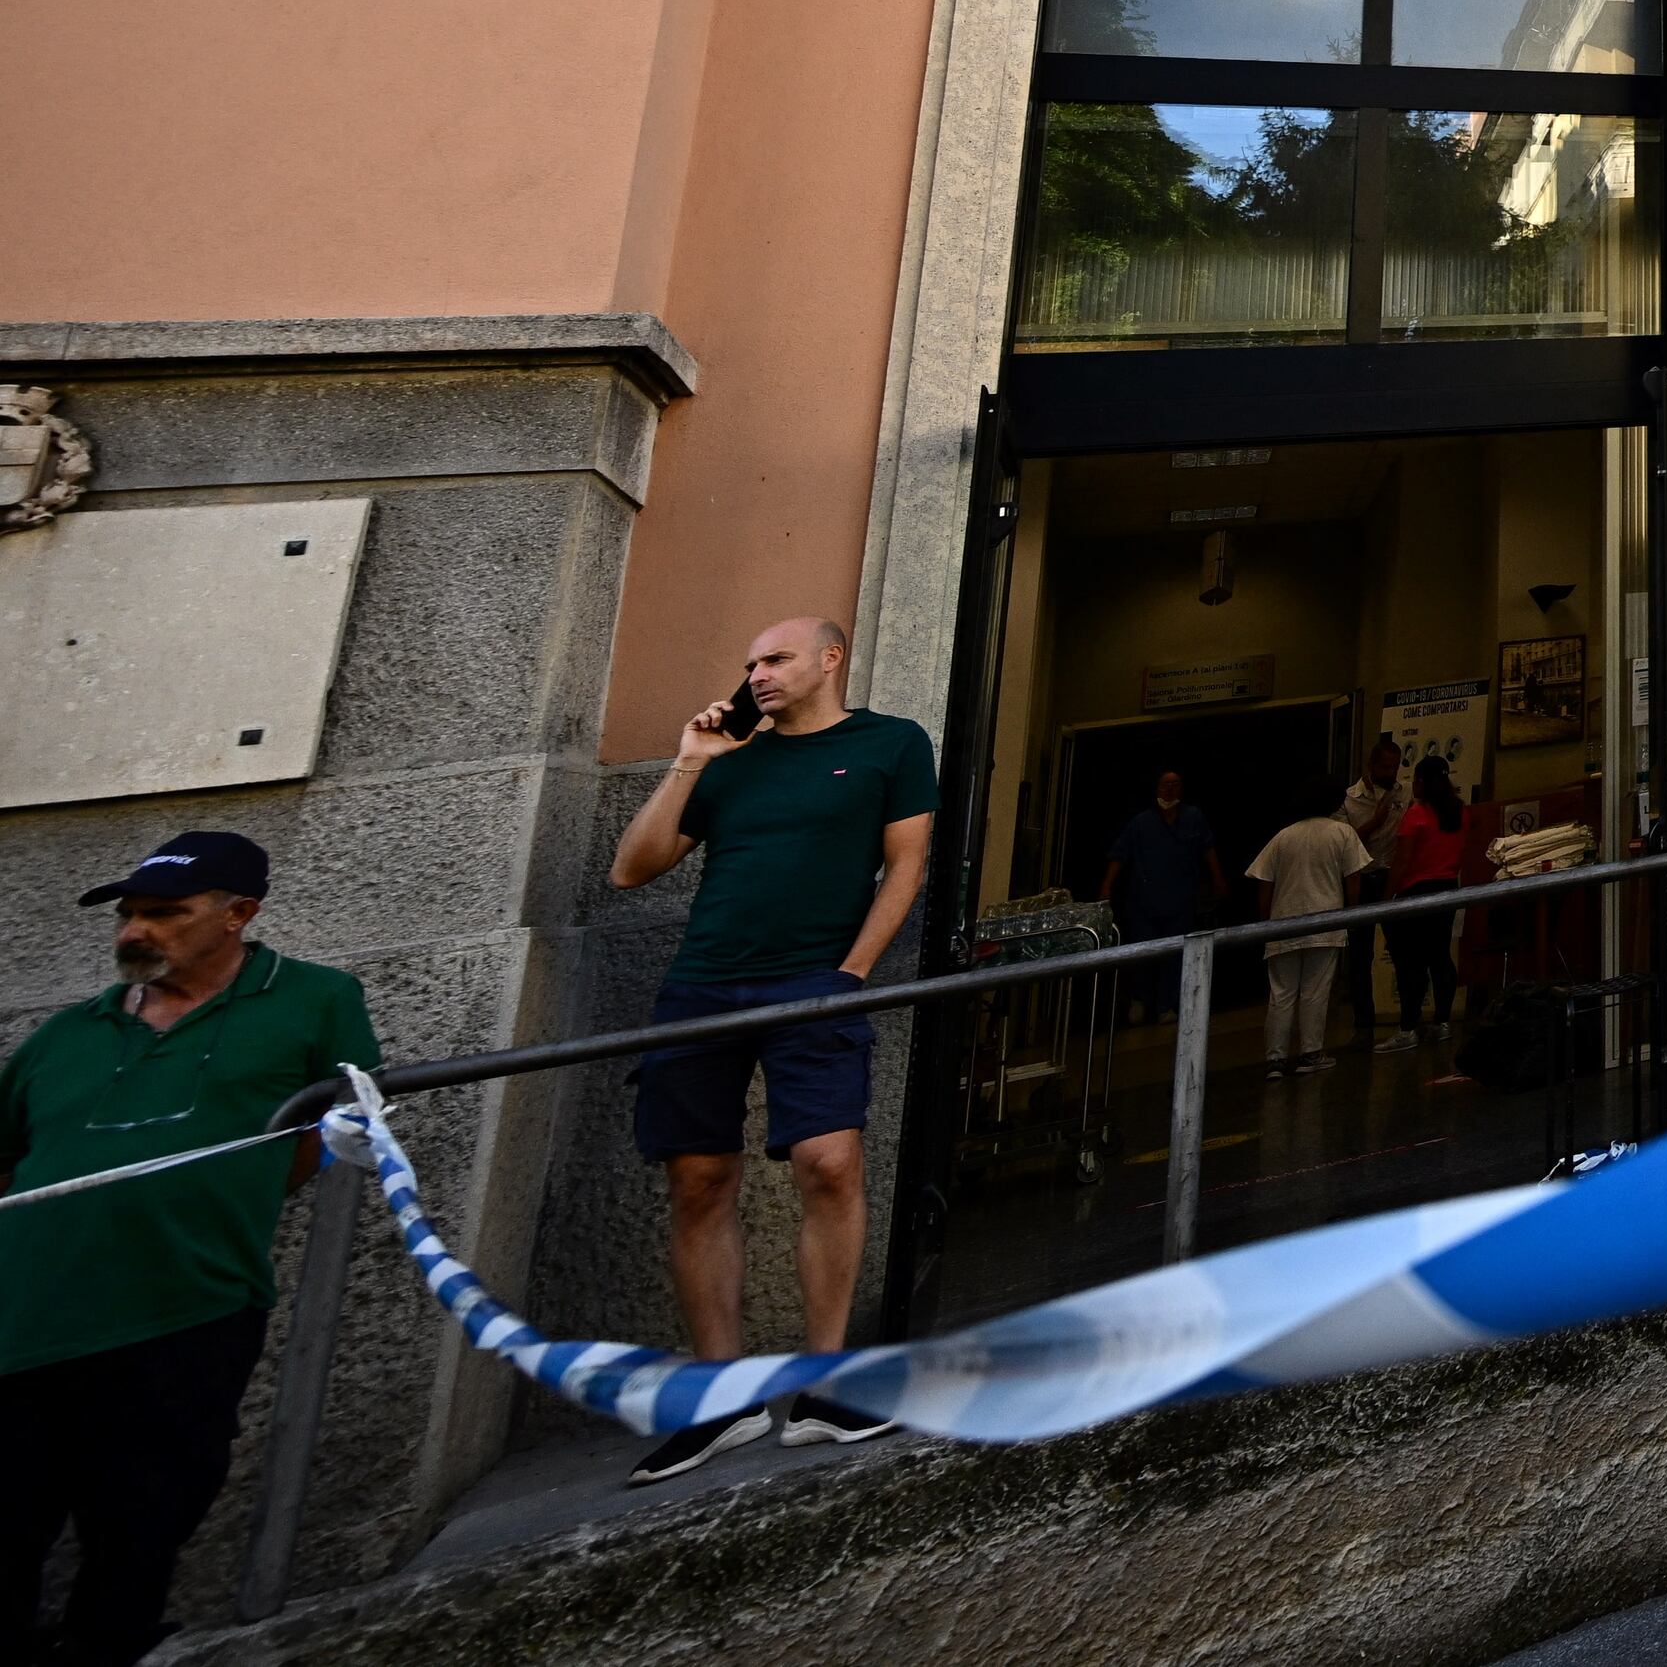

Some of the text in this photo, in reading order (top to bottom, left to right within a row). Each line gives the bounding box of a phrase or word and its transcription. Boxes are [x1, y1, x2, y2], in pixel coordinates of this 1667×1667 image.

[1396, 690, 1427, 705] COVID-19
[1431, 683, 1478, 700] CORONAVIRUS
[1403, 700, 1468, 719] COME COMPORTARSI
